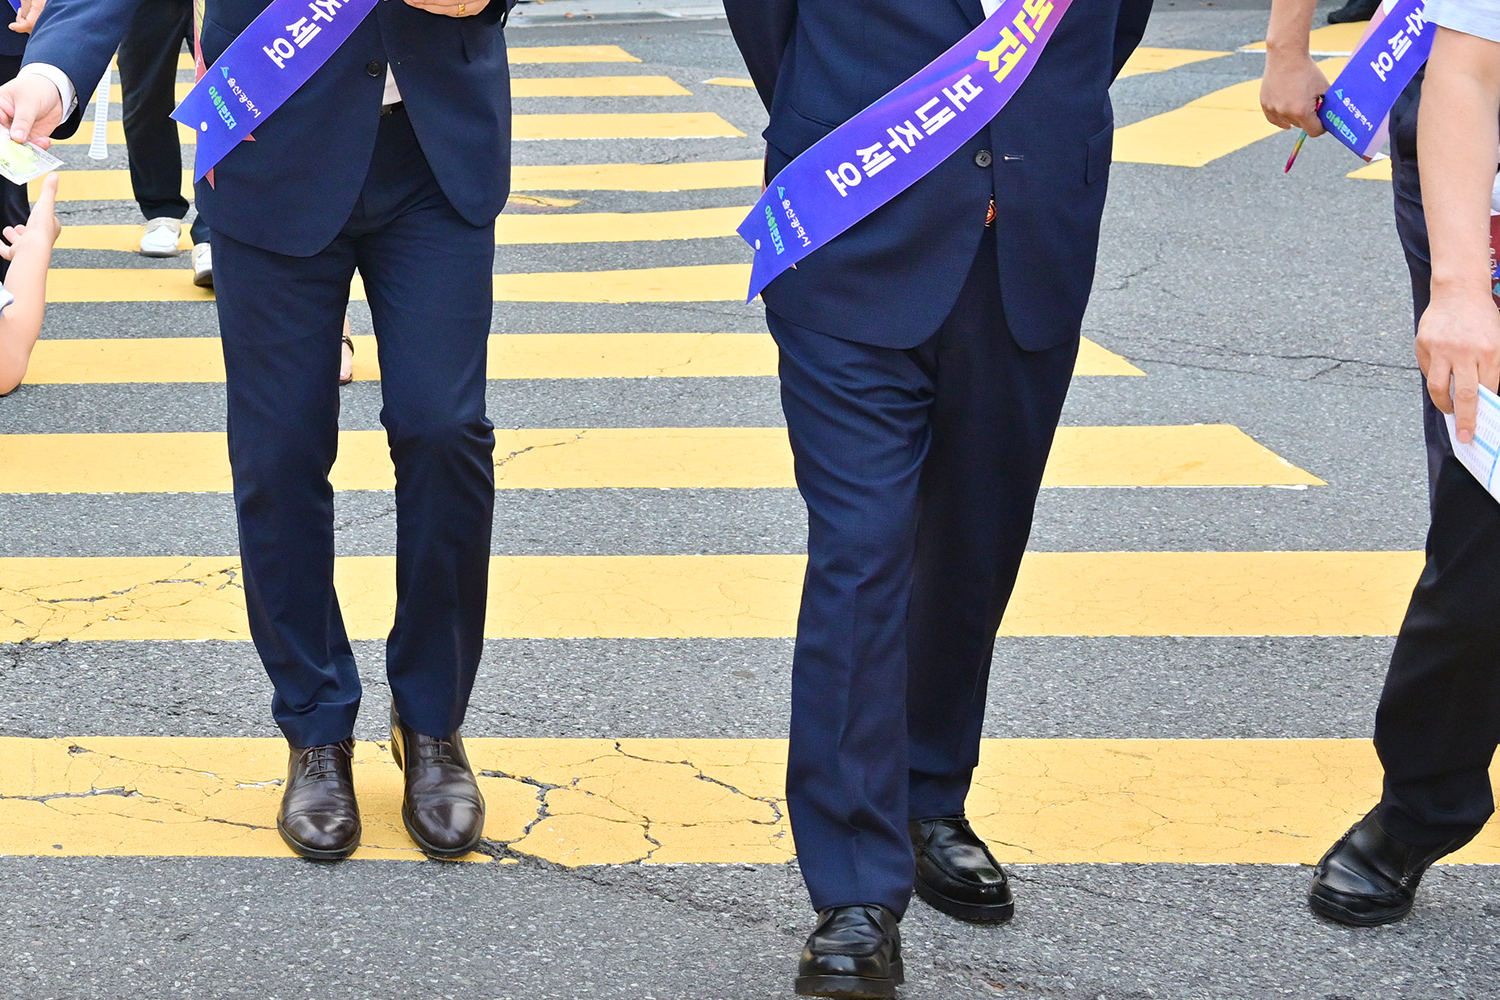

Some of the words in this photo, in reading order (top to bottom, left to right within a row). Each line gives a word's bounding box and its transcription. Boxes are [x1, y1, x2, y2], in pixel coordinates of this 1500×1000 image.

[208, 86, 238, 131] 아이먼저
[227, 77, 262, 119] 울산광역시
[1342, 97, 1374, 132] 울산광역시
[825, 73, 984, 197] 보내주세요
[765, 205, 785, 256] 아이먼저
[782, 199, 812, 248] 울산광역시
